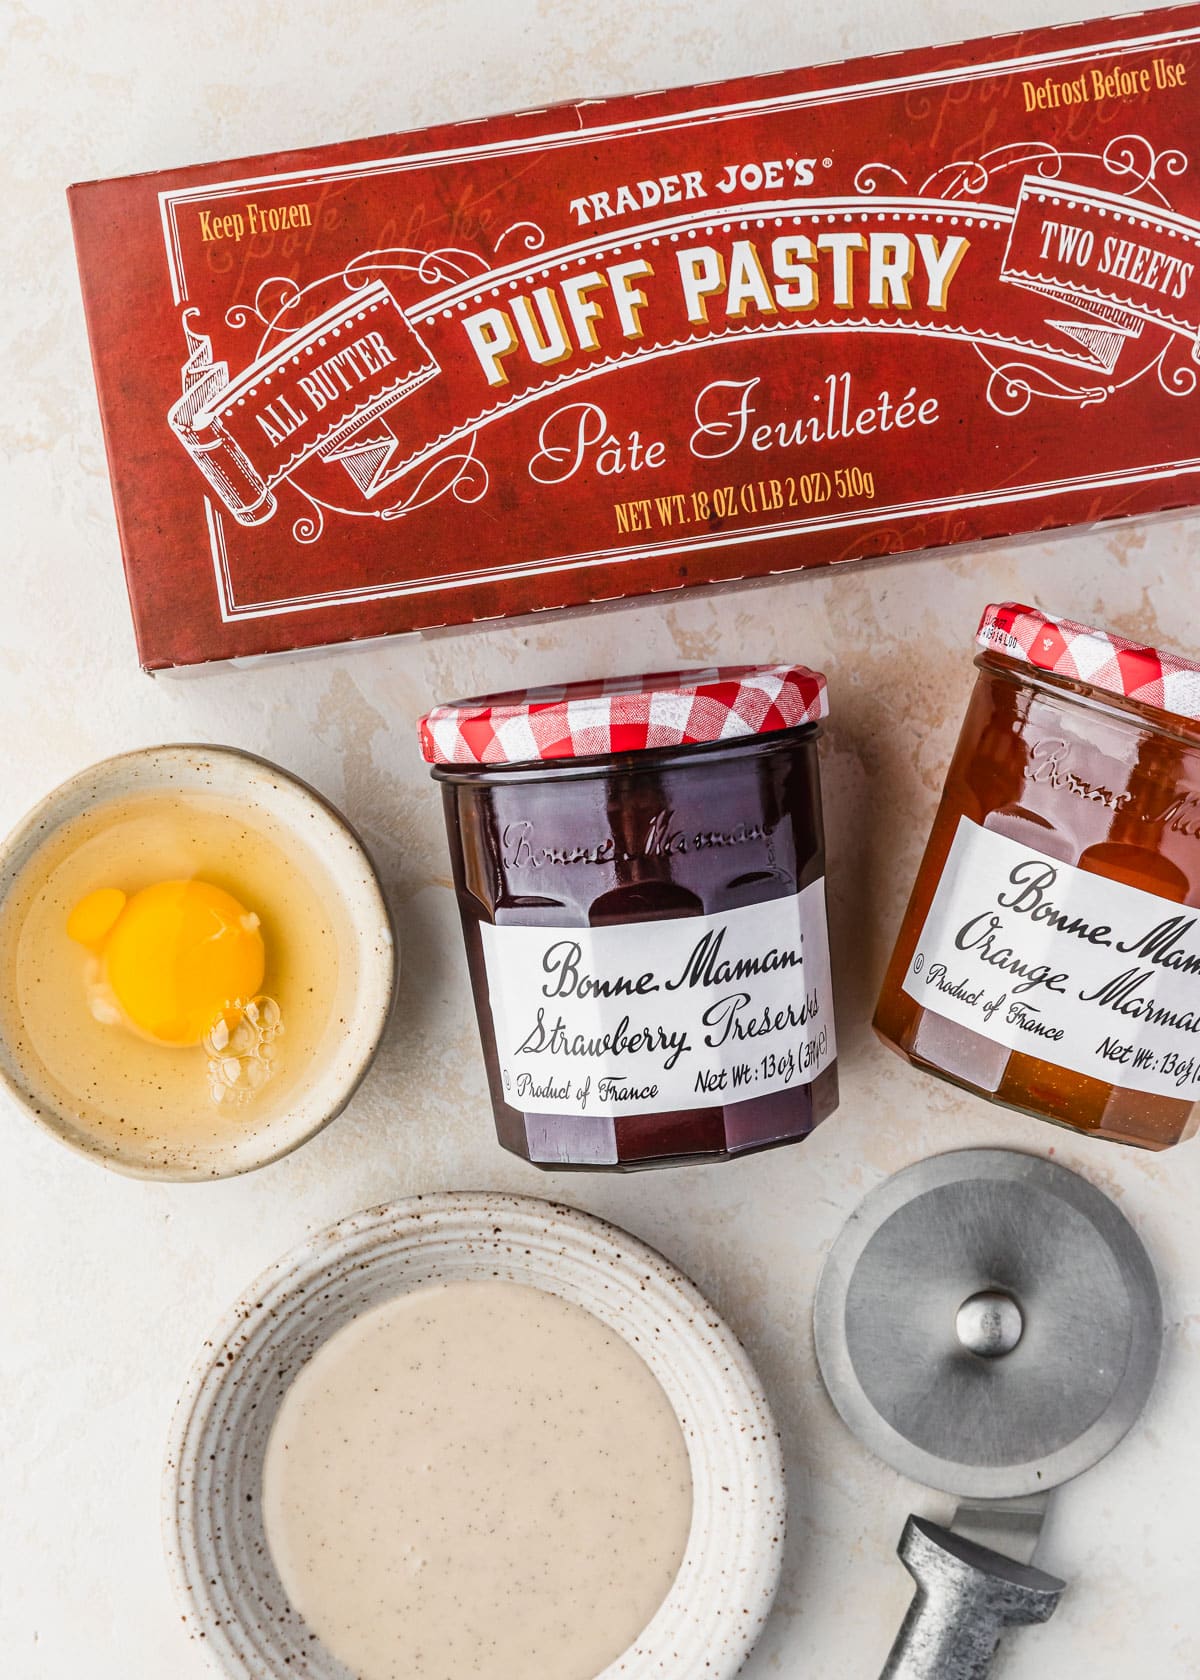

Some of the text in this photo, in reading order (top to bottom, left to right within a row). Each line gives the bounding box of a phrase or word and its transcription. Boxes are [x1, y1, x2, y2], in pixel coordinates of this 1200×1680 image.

[1022, 58, 1187, 112] Defrost Before Use
[198, 203, 313, 242] Keep Frozen
[569, 171, 708, 226] TRADER
[1039, 220, 1195, 299] TWO SHEETS
[460, 232, 971, 388] PUFF PASTRY
[255, 331, 398, 448] ALL BUTTER
[528, 371, 941, 485] Pâte Feuilletée
[614, 466, 875, 534] NET WT. 18 OZ (1 LB 2 OZ) 510g
[997, 860, 1112, 947] Bonne
[542, 940, 660, 999] Bonne
[955, 911, 1069, 994] Orange
[926, 963, 985, 1006] Product
[982, 993, 1007, 1022] of
[1006, 1001, 1065, 1042] France
[514, 1007, 692, 1070] Strawberry
[1095, 1036, 1133, 1064] Net
[516, 1072, 572, 1100] Product
[576, 1075, 591, 1110] of
[598, 1076, 659, 1102] France
[694, 1068, 727, 1094] Net
